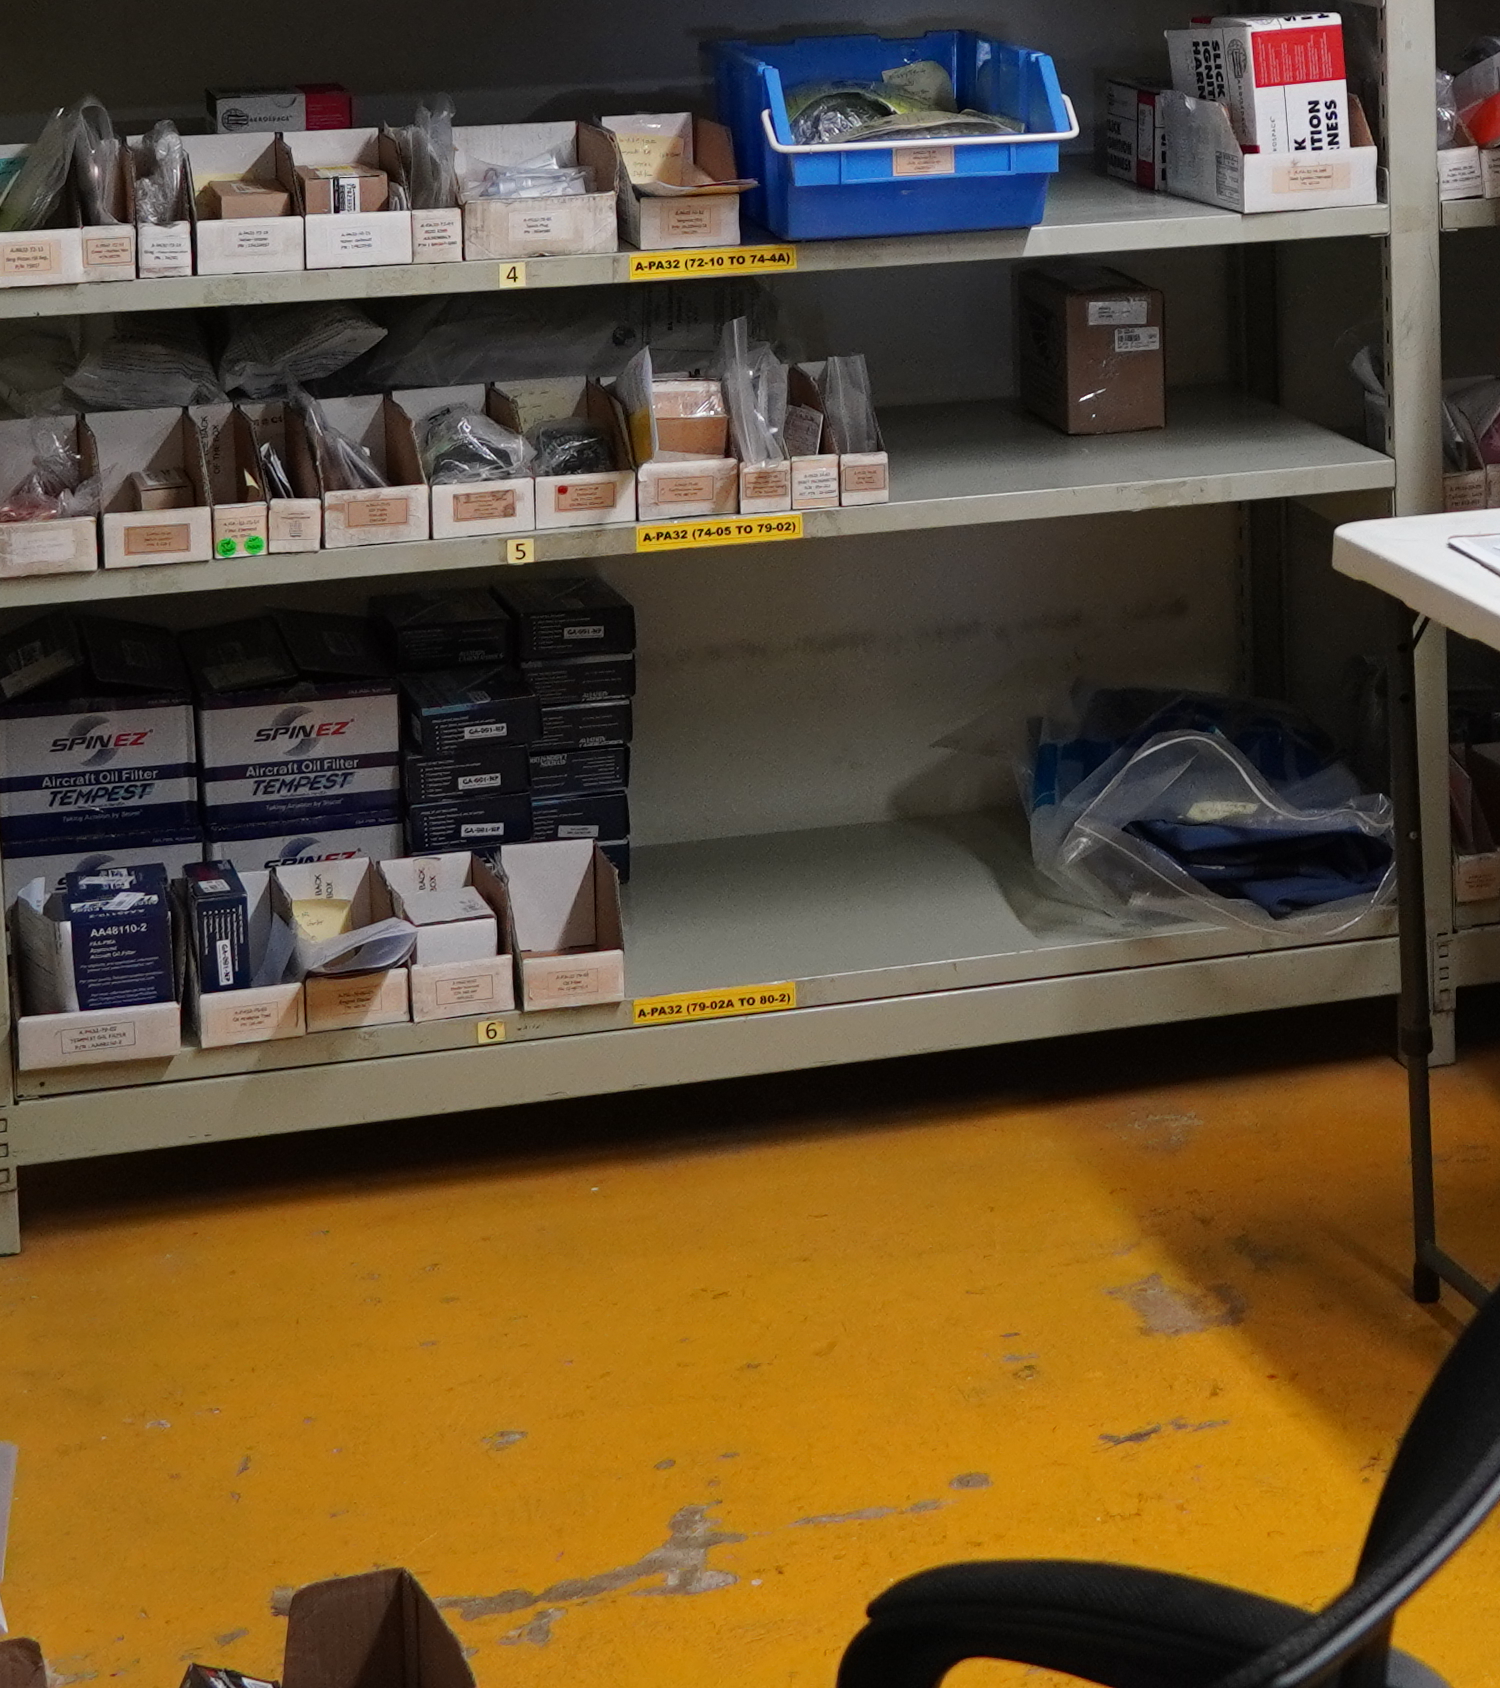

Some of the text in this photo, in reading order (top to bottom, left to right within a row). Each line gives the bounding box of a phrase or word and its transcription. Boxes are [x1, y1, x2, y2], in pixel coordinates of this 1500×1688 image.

[1192, 40, 1206, 101] HARN
[1201, 40, 1216, 102] IGNIT
[1211, 39, 1225, 99] SLICK
[1307, 99, 1322, 151] ITION
[1325, 98, 1338, 151] NESS
[505, 264, 519, 284] 4
[634, 252, 791, 272] A-PA32 (72-10 TO 74-4A)
[642, 520, 797, 545] A-PA32 (74-05 TO 79-02)
[514, 542, 526, 560] 5
[41, 768, 159, 789] Aircraft Oil Filter
[244, 757, 359, 779] Aircraft Oil Filter
[47, 783, 156, 808] TEMPEST
[252, 771, 355, 796] TEMPEST
[314, 873, 322, 897] BACK
[325, 881, 334, 899] BOX
[418, 868, 426, 892] BACK
[89, 921, 149, 938] AA48110-2
[637, 993, 792, 1019] A-PA32 (79-02A TO 80-2)
[484, 1021, 498, 1040] 6
